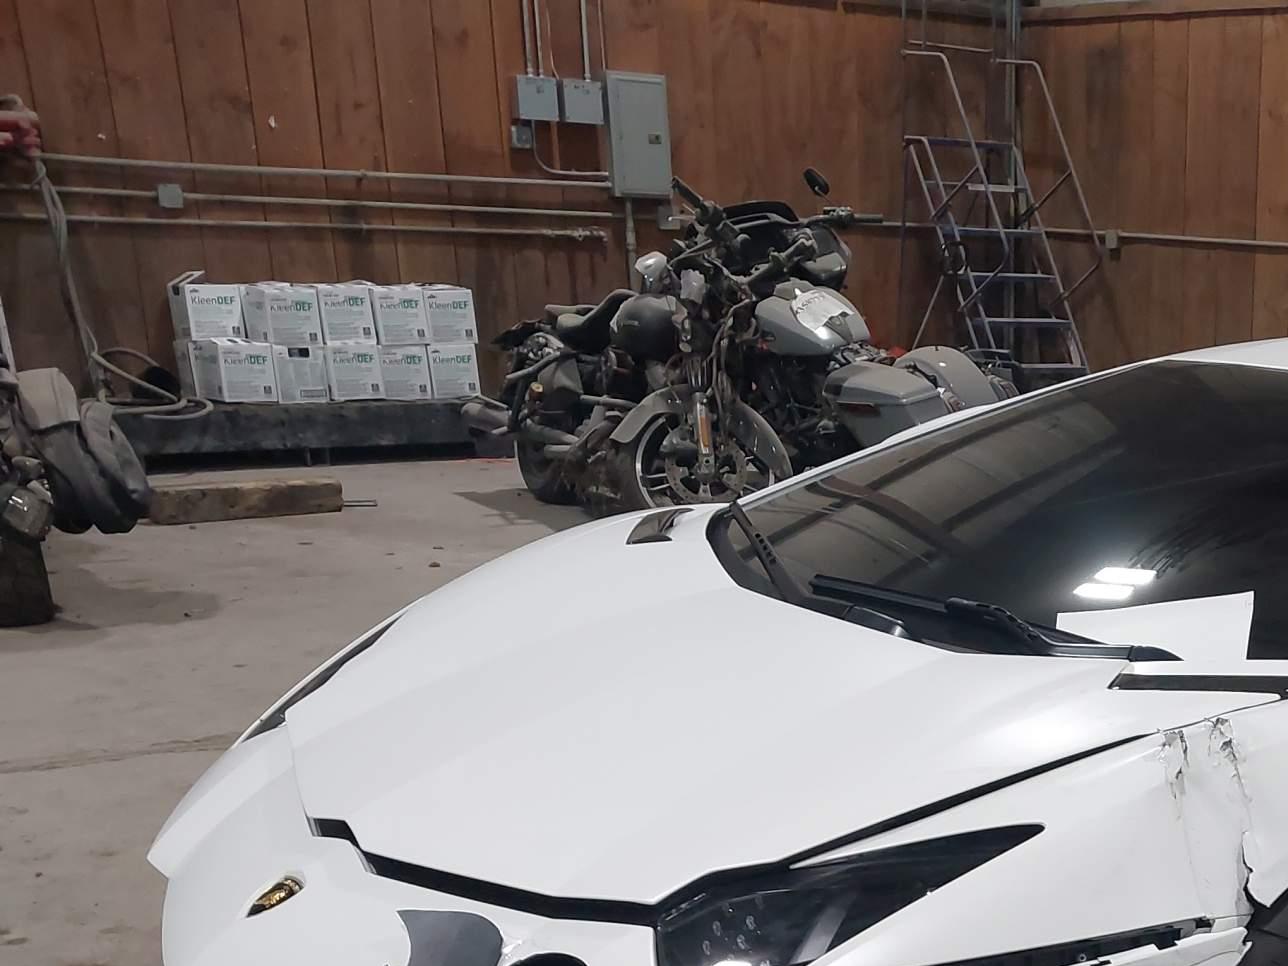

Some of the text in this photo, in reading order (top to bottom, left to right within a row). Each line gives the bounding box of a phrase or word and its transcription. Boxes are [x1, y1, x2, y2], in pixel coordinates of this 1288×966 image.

[190, 296, 235, 305] KleenDEF
[428, 300, 469, 310] KleenDEF
[432, 354, 472, 364] KleenDEF
